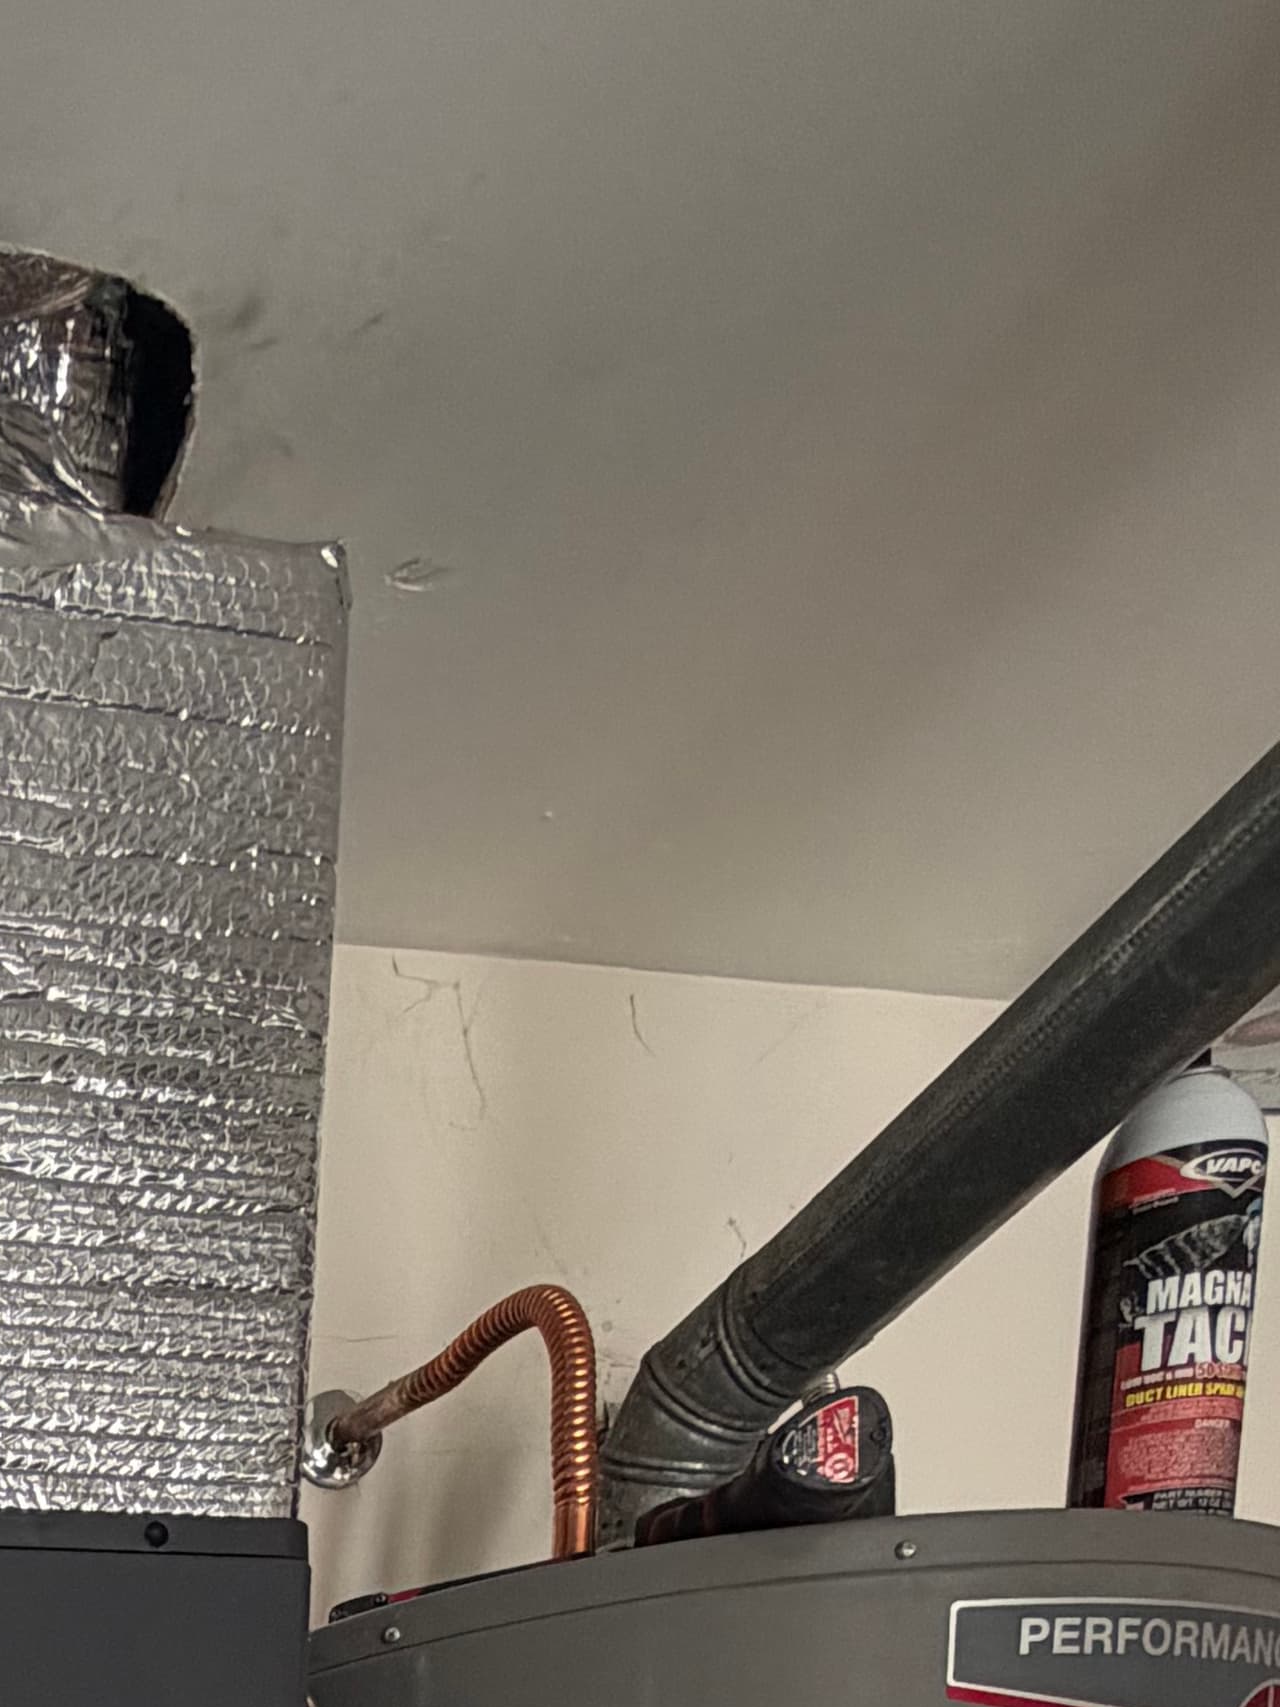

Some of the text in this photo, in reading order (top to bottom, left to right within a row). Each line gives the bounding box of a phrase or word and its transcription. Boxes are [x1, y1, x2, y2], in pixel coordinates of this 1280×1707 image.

[1146, 1270, 1252, 1316] MAGNA
[1134, 1305, 1248, 1372] TAC
[1125, 1385, 1164, 1408] DUCT
[1166, 1382, 1203, 1399] LINER
